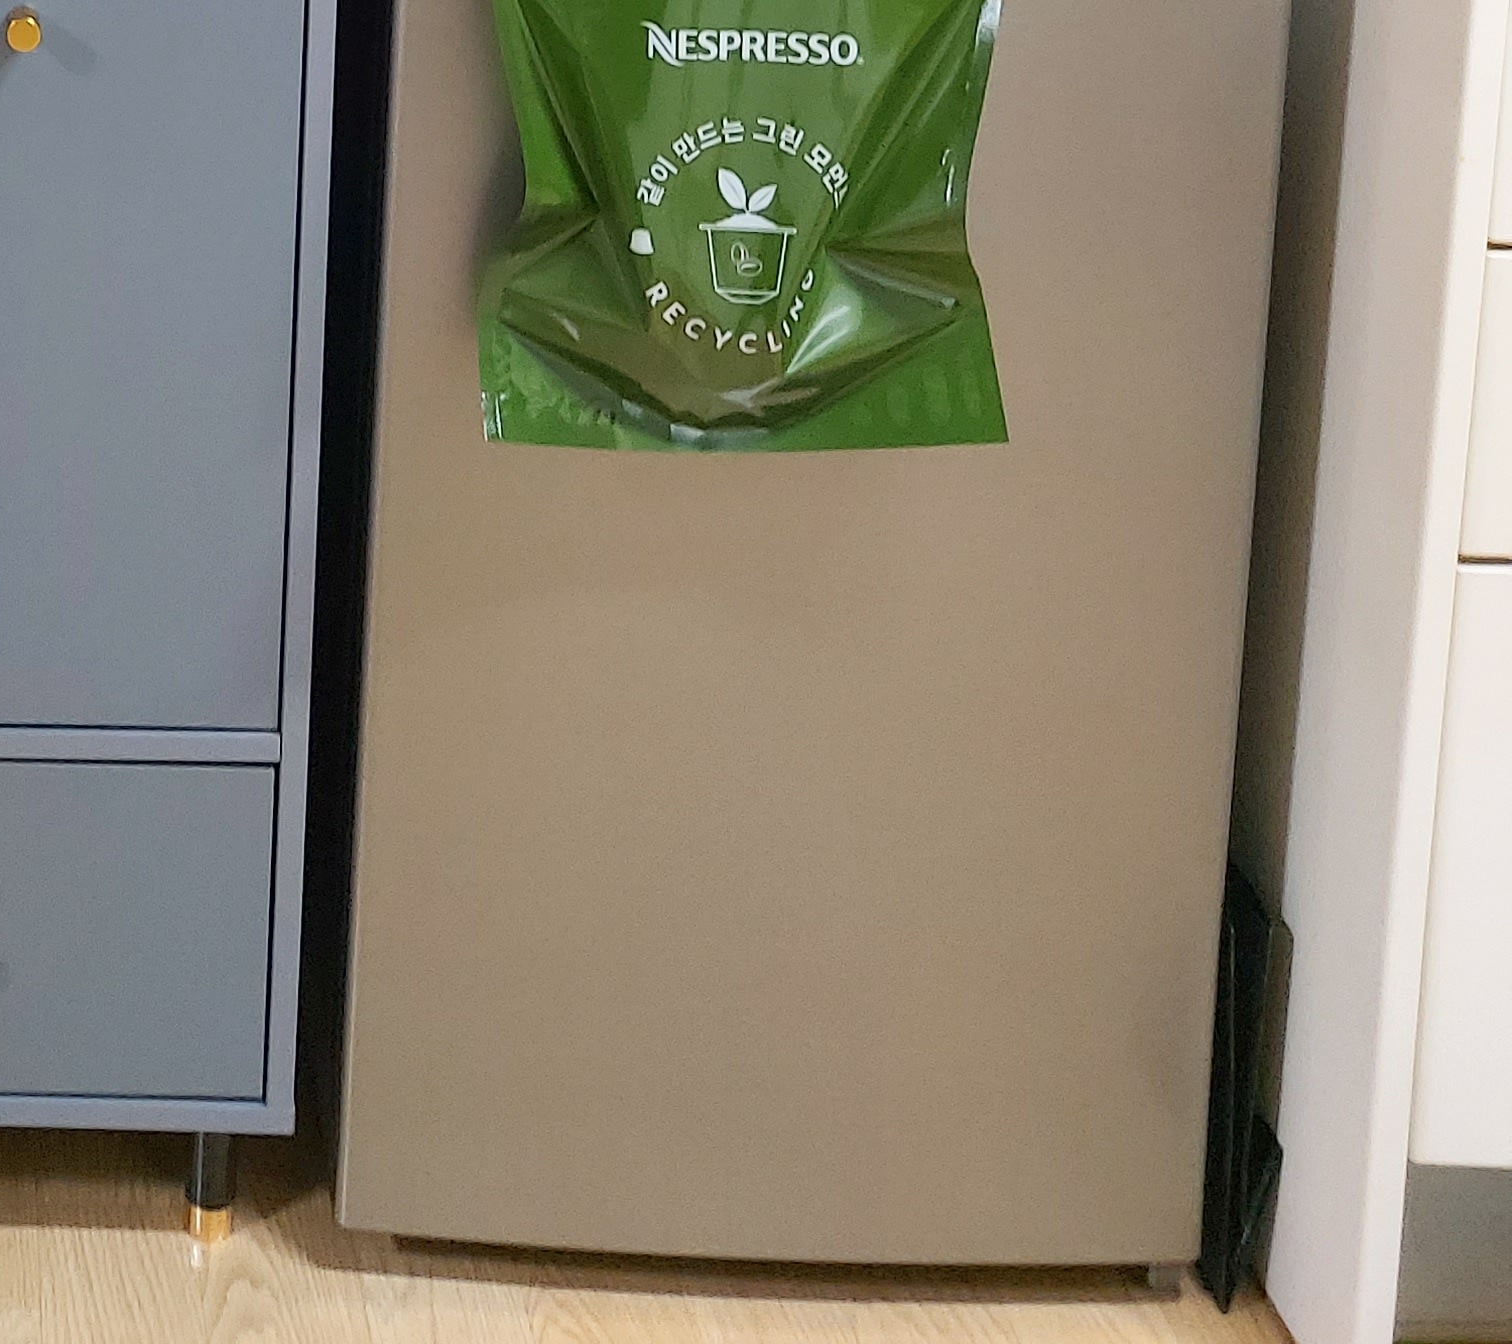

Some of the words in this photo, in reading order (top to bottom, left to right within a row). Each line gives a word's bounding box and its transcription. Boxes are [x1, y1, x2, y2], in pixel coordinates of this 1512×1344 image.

[640, 20, 859, 67] NESPRESSO
[637, 155, 679, 207] 같이
[671, 116, 746, 164] 만드는
[752, 116, 805, 156] 그린
